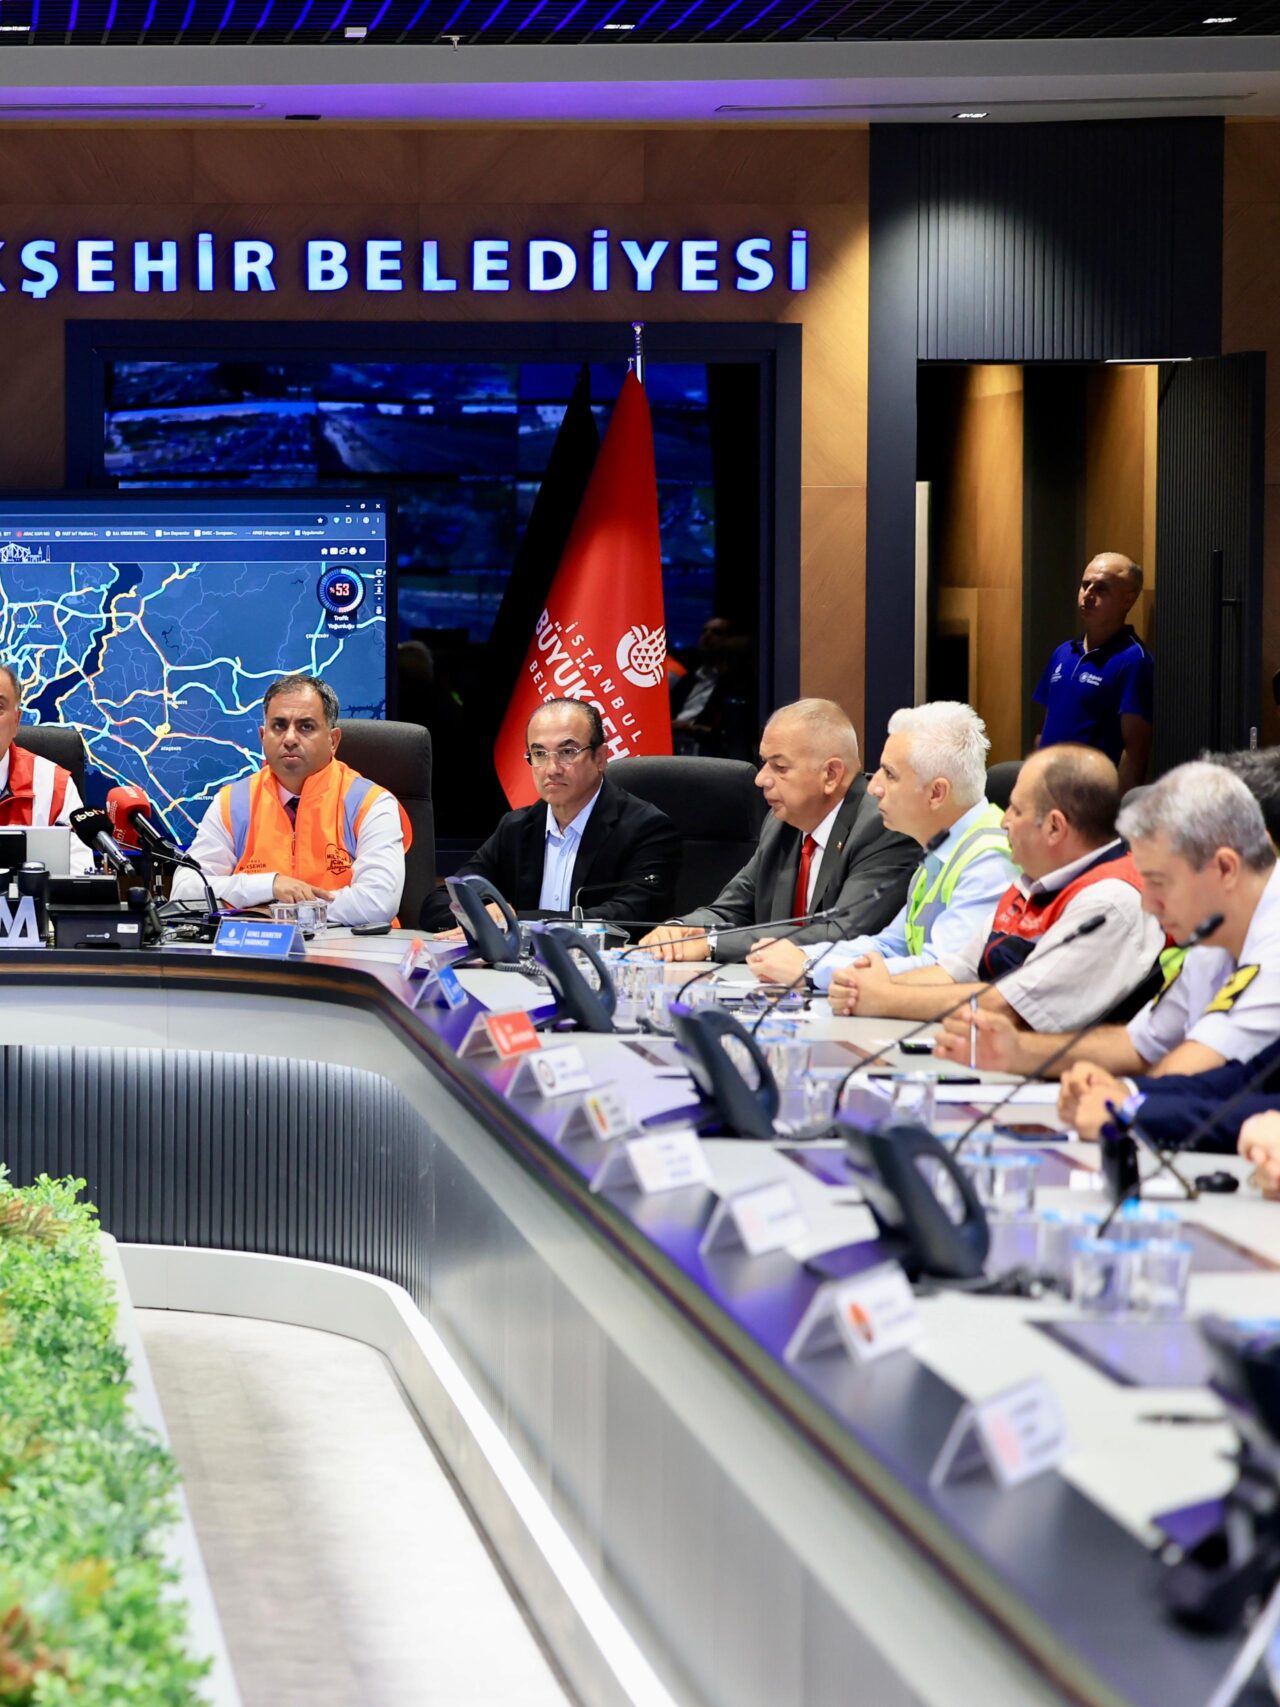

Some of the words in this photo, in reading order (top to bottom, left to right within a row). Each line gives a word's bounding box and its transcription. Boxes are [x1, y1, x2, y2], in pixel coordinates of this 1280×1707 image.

[306, 229, 808, 292] BELEDİYESİ
[535, 607, 631, 764] BÜYÜKEH
[564, 621, 643, 743] İSTANBUL
